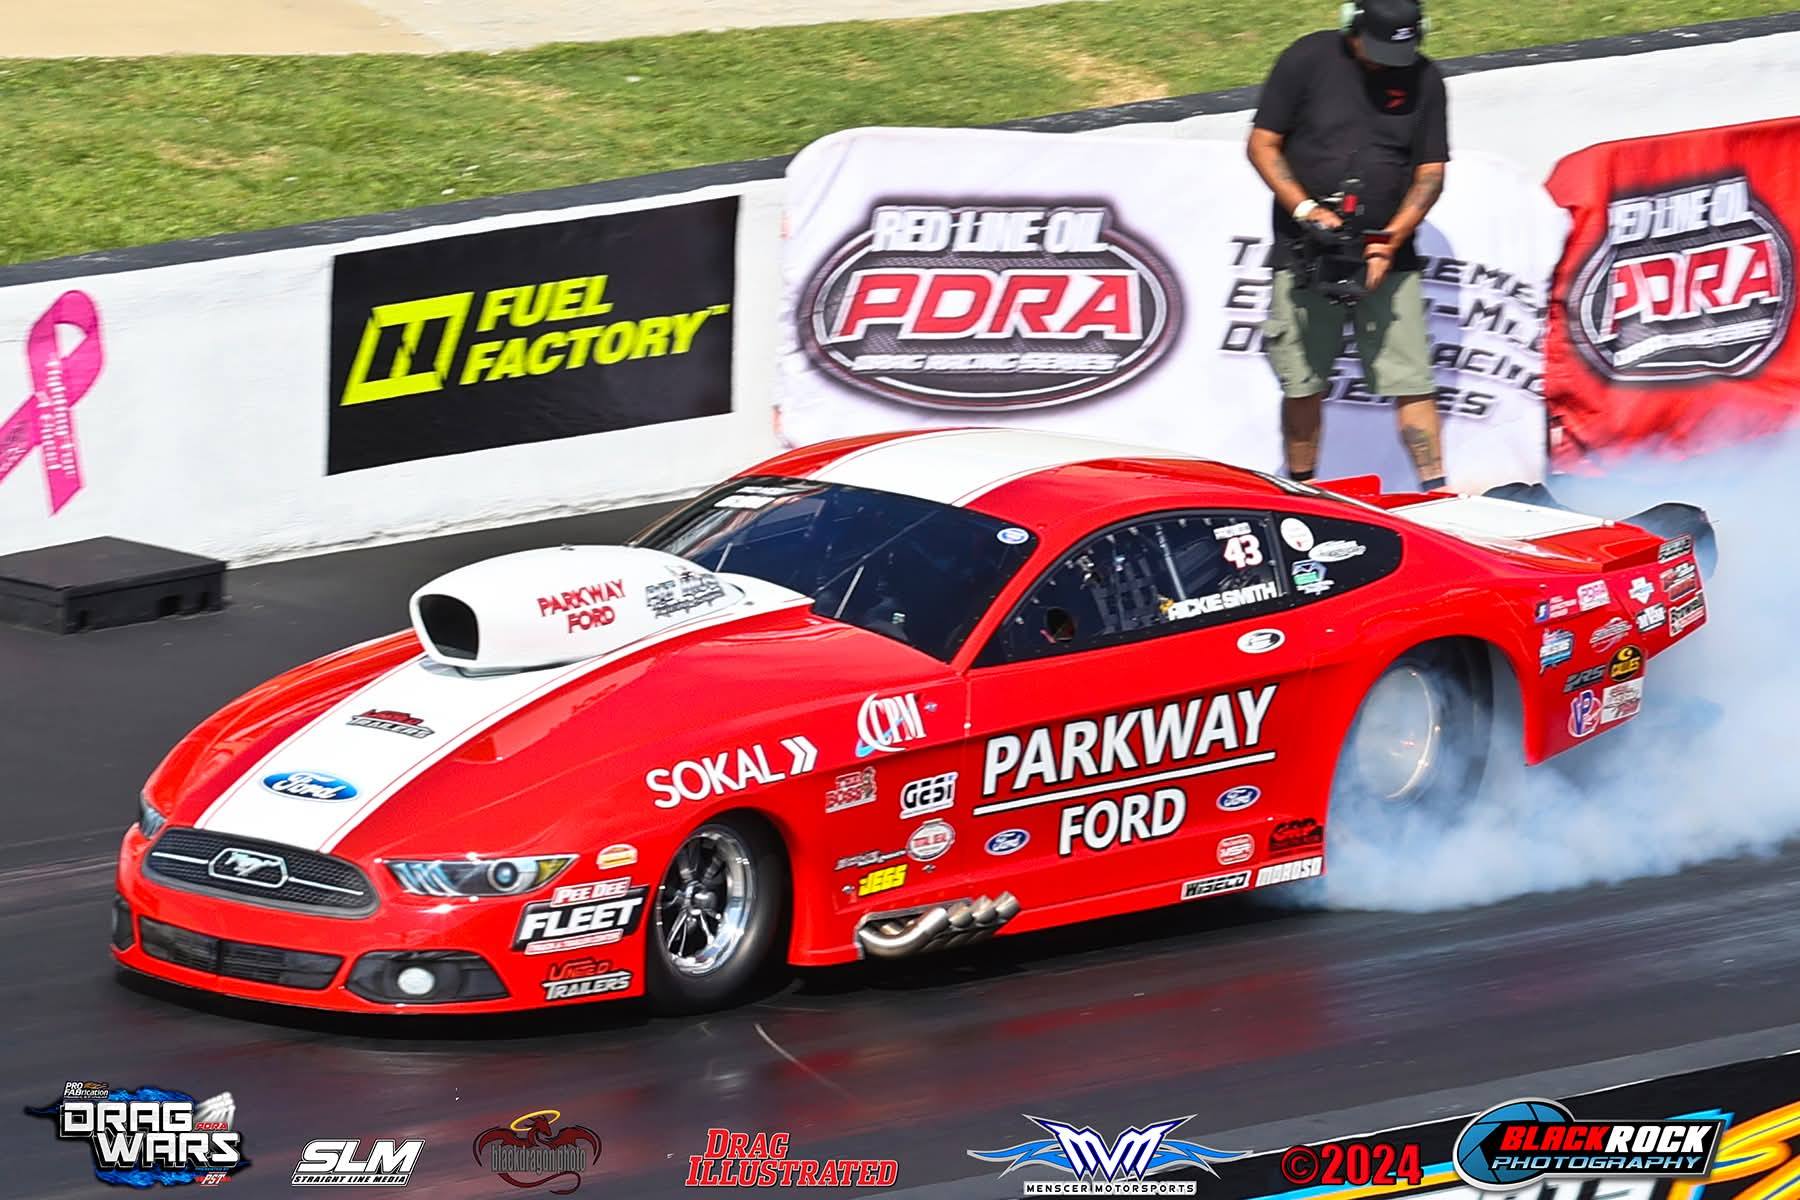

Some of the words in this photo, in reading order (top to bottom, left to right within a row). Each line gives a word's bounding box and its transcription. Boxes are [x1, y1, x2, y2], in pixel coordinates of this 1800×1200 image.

[871, 208, 951, 252] RED
[952, 209, 1045, 252] LINE
[1044, 209, 1108, 252] OIL
[476, 275, 614, 332] FUEL
[829, 269, 1142, 340] PDRA
[1596, 234, 1783, 344] PDRA
[1223, 533, 1264, 569] 43
[536, 579, 627, 617] PARKWAY
[566, 606, 616, 633] FORD
[857, 692, 927, 753] CPM
[983, 684, 1278, 796] PARKWAY
[271, 772, 347, 799] Ford
[645, 744, 786, 809] SOKAL
[1222, 789, 1254, 808] Ford
[990, 832, 1027, 853] Ford
[1059, 787, 1187, 856] FORD
[554, 886, 593, 905] PEE
[590, 880, 629, 899] DEE
[518, 897, 643, 941] FLEET
[542, 970, 632, 1000] TRAILERS
